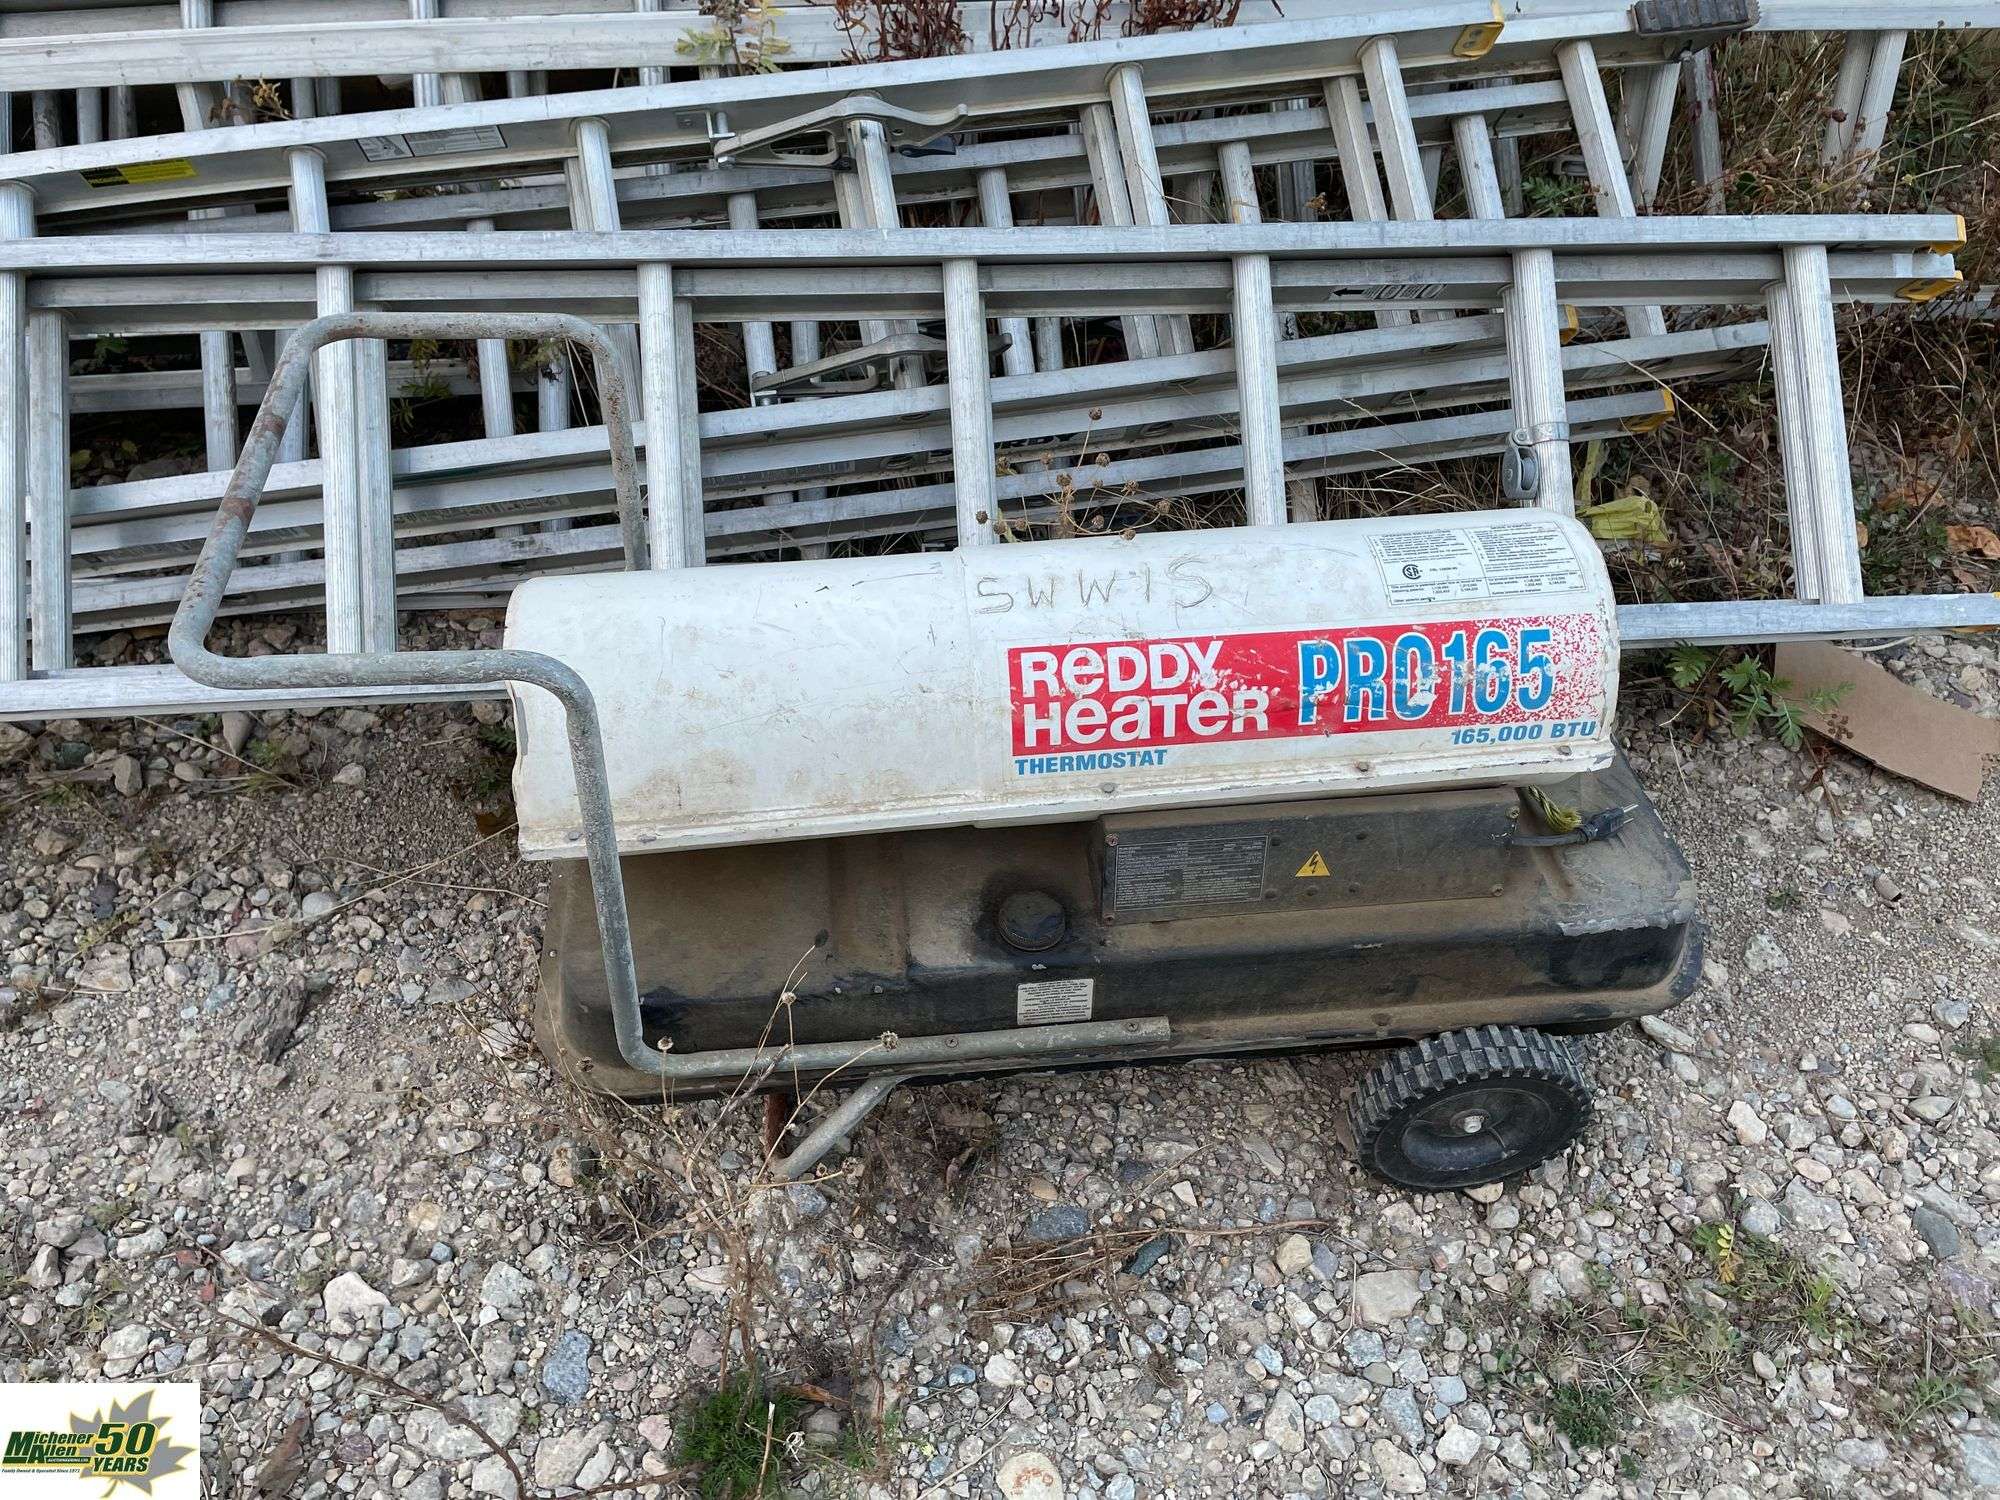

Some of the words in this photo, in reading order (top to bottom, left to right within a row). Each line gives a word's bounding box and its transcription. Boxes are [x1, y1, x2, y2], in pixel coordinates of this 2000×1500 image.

[1297, 626, 1555, 726] PRO165
[1451, 724, 1542, 746] 165,000
[1550, 721, 1597, 740] BTU
[1015, 749, 1168, 775] THERMOSTAT
